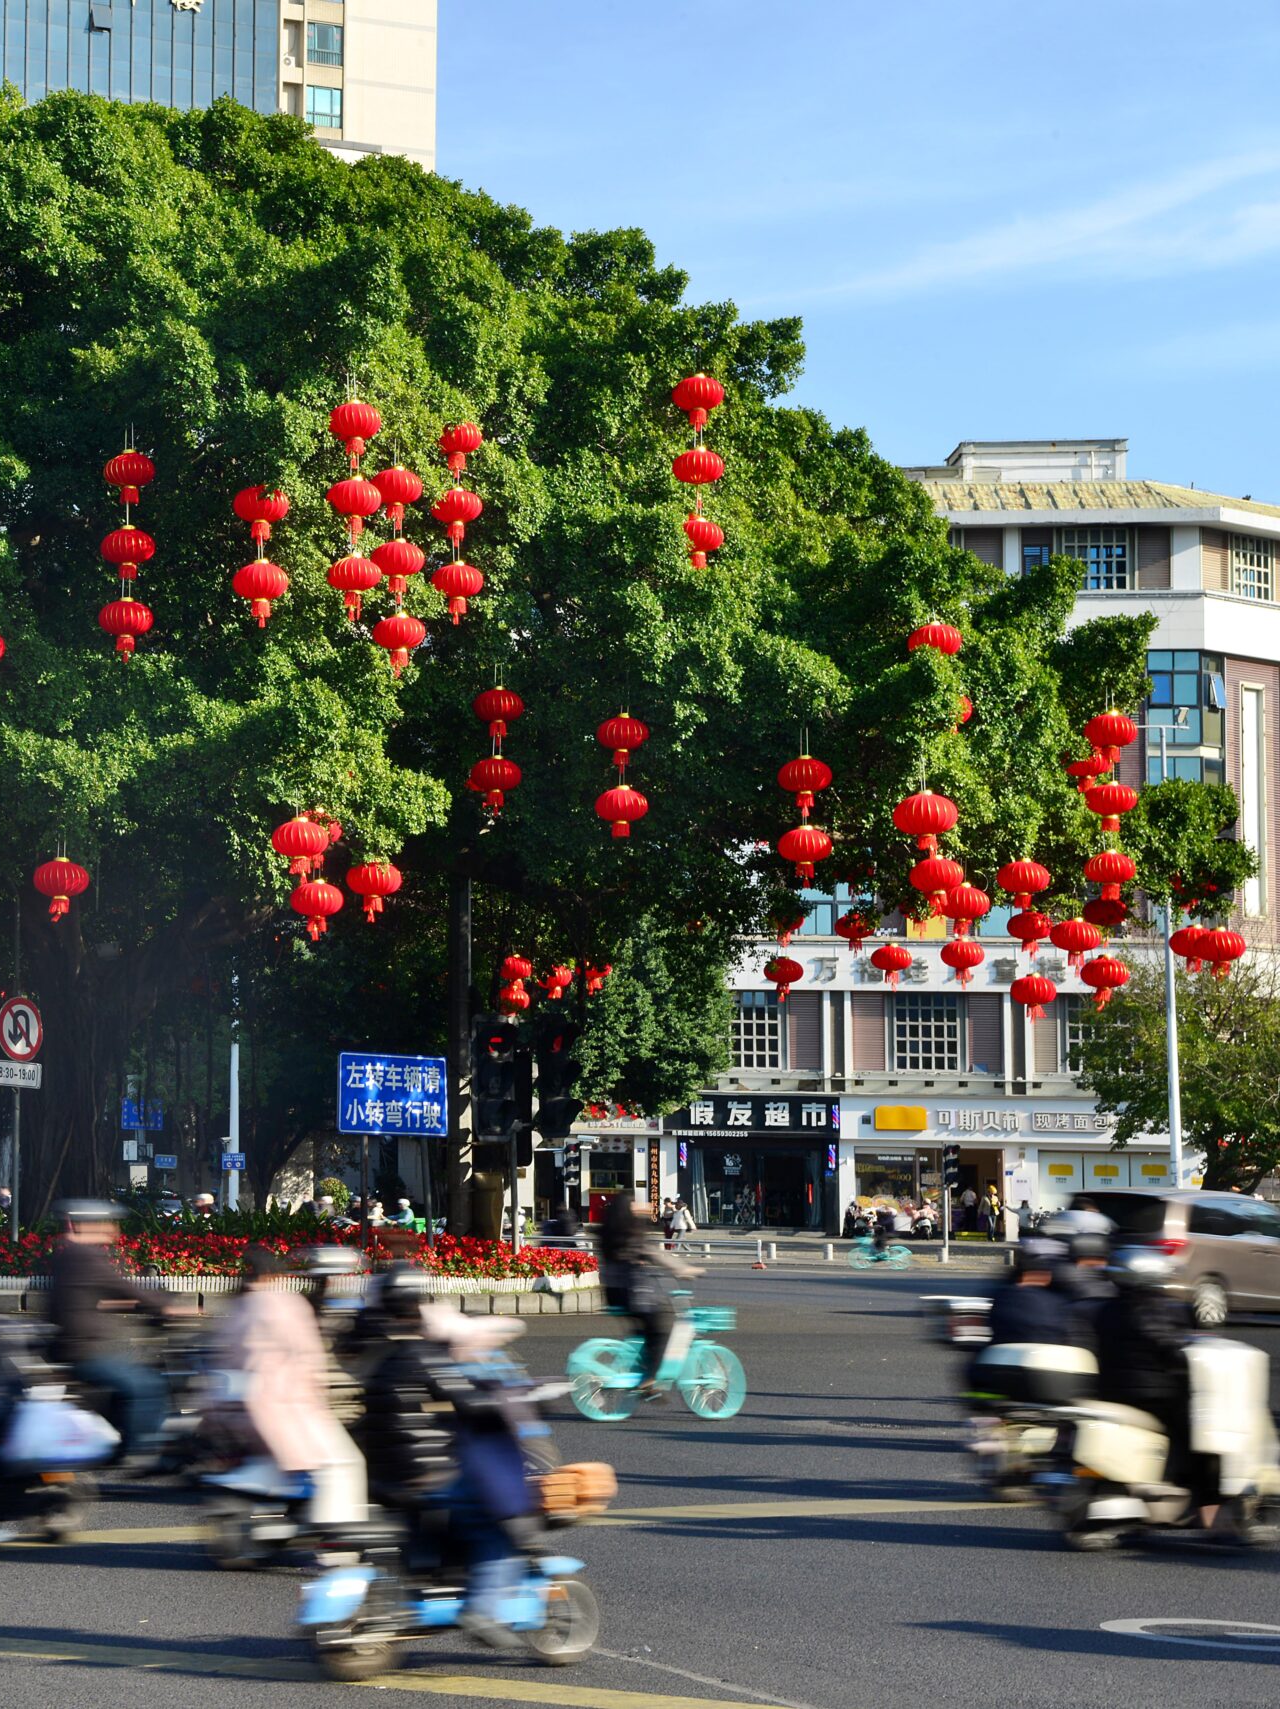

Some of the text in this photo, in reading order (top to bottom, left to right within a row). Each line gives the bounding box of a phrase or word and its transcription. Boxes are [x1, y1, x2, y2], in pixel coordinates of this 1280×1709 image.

[813, 956, 1067, 984] 万福佳童摄
[346, 1061, 441, 1094] 左转车辆请
[345, 1098, 442, 1129] 小转弯行驶
[689, 1101, 827, 1127] 假发超市
[1035, 1113, 1109, 1129] 现烤面包
